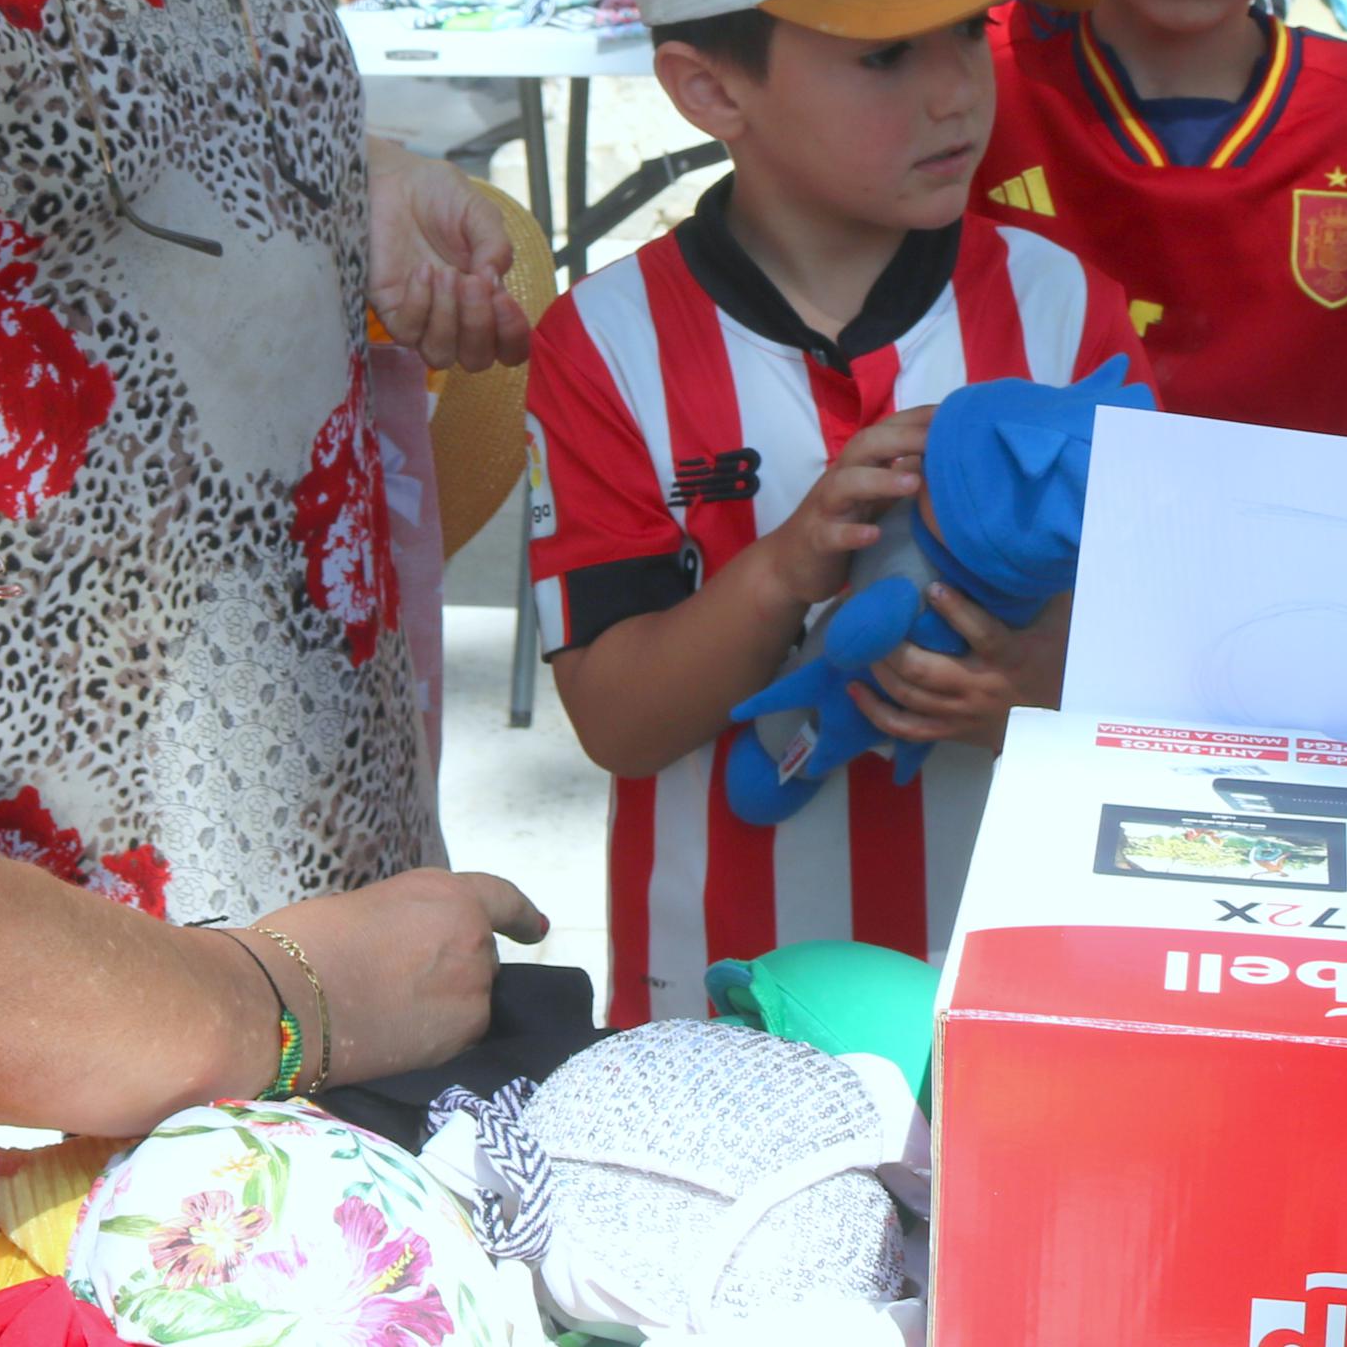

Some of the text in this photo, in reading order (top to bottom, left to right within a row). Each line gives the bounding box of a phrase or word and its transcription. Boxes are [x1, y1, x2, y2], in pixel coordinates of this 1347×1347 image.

[1098, 724, 1283, 747] MANDO A DISTANCIA
[1120, 738, 1262, 759] ANTI-SALTOS
